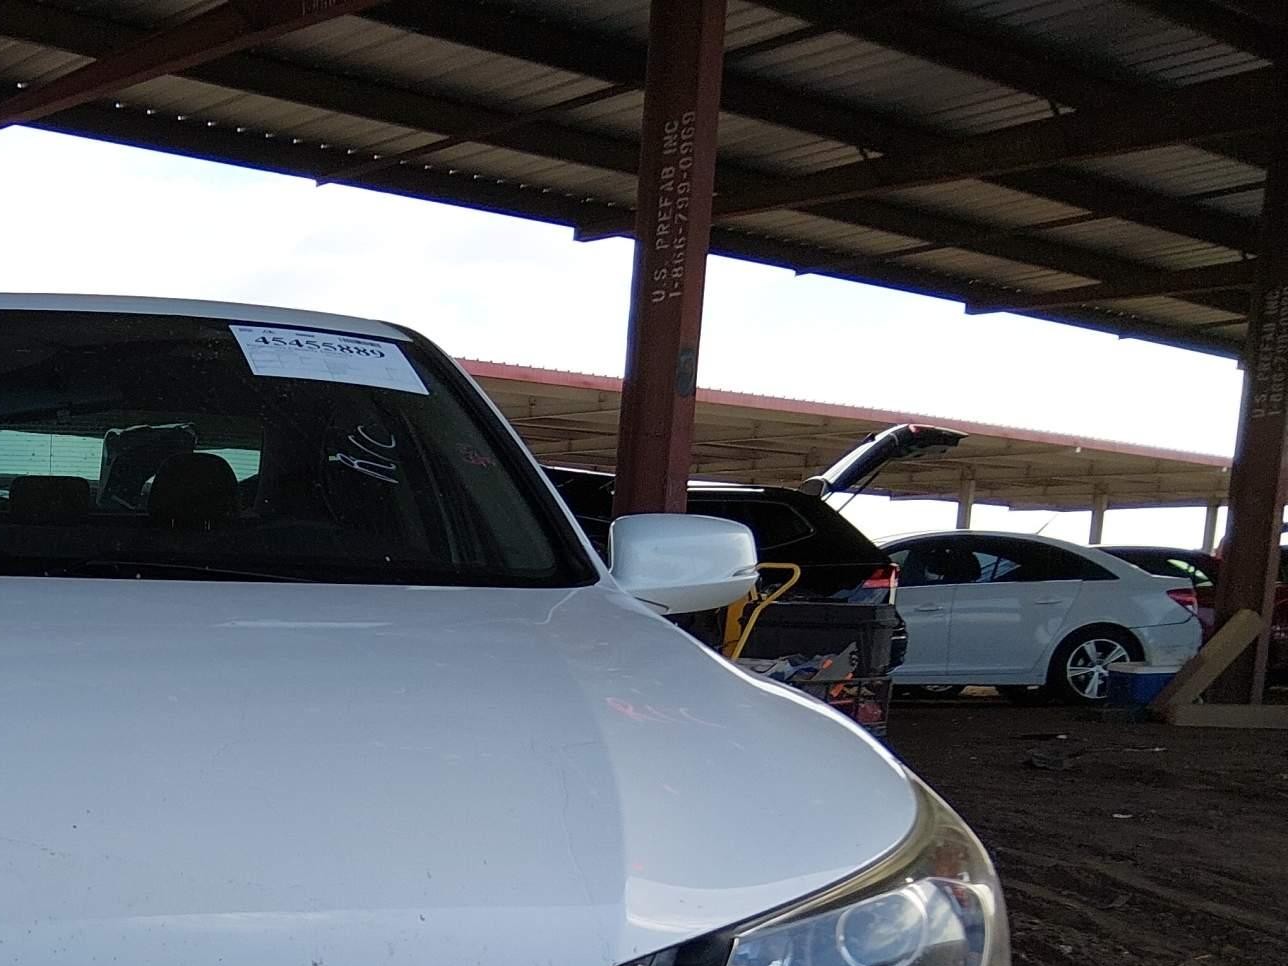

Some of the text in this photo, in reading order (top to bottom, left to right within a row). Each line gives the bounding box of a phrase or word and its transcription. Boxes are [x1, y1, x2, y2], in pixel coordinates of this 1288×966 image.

[663, 120, 680, 156] INC
[655, 166, 676, 250] PREFAB
[254, 335, 386, 360] 45455889
